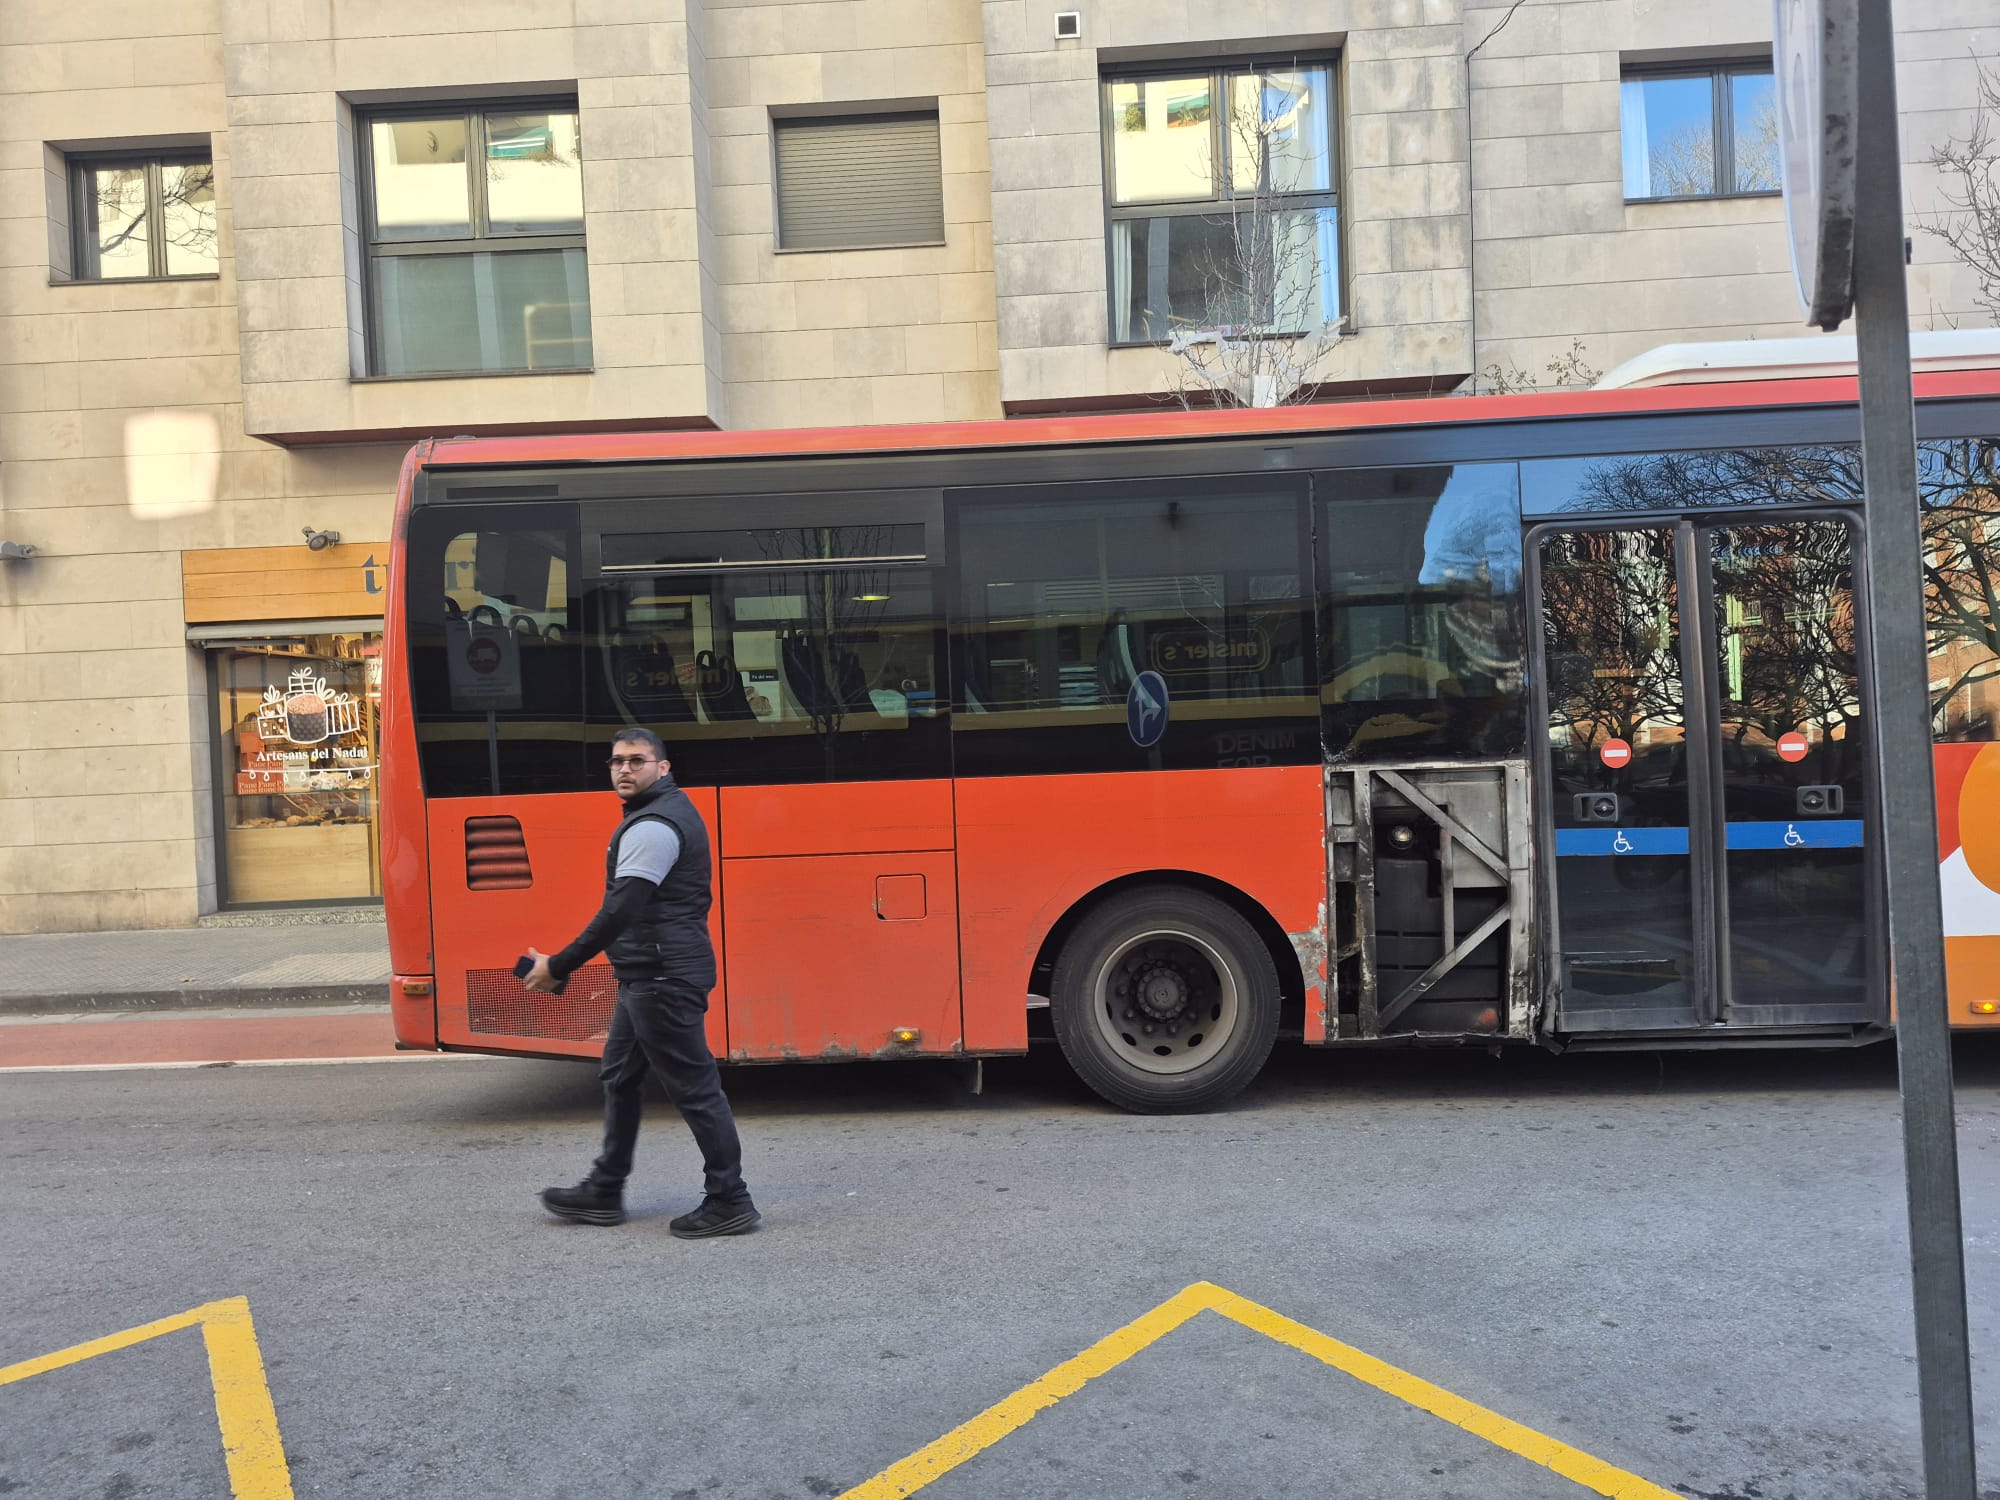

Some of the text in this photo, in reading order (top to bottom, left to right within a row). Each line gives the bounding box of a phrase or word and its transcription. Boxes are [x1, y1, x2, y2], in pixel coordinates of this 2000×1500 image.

[1216, 732, 1296, 753] DENIM
[256, 746, 368, 762] Artesans del Nadal
